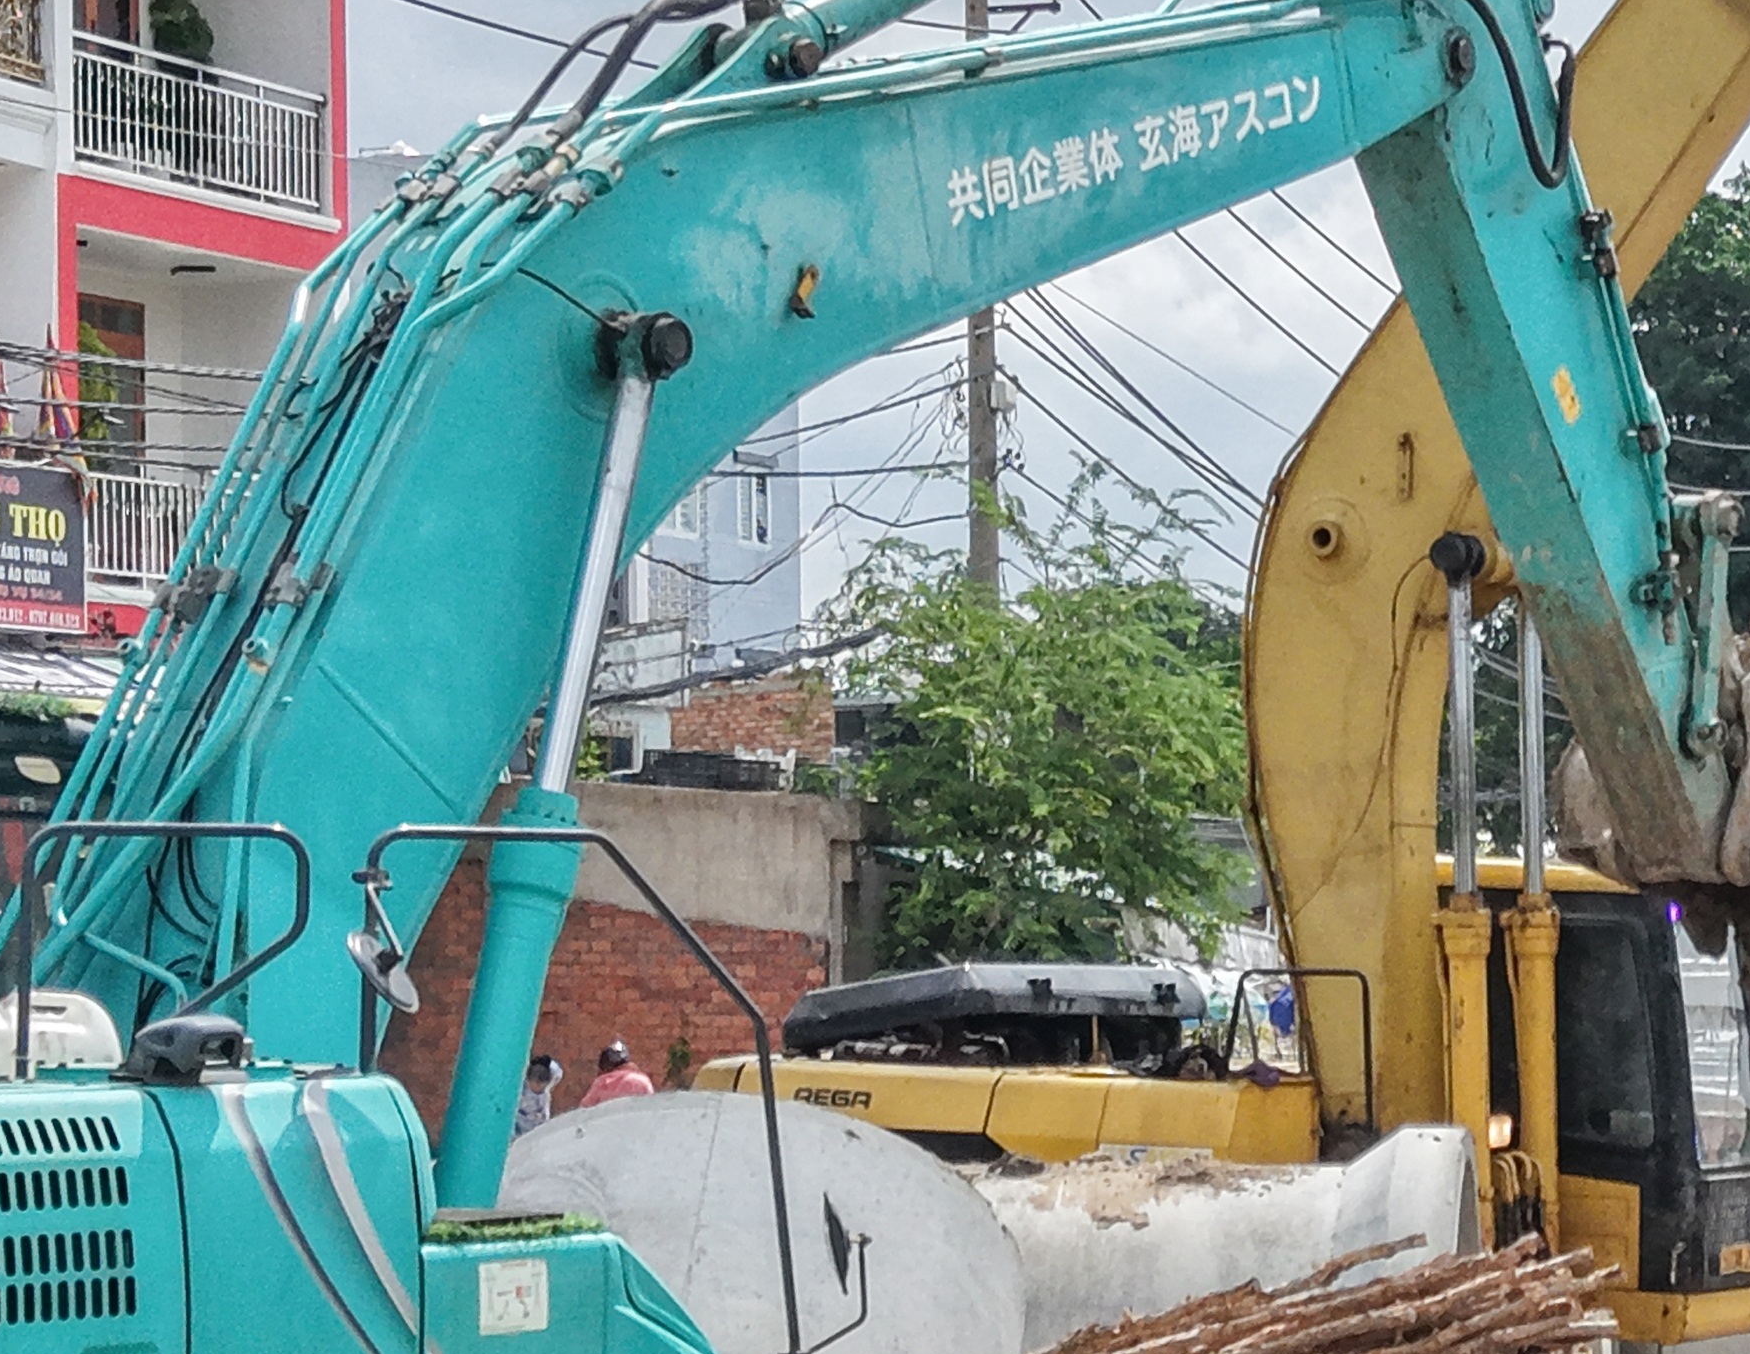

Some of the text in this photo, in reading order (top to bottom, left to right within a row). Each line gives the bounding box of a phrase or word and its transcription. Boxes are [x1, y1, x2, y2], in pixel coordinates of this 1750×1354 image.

[948, 76, 1320, 227] 共同企業体 玄海アスコン
[9, 503, 66, 547] THỌ
[7, 563, 21, 582] ÁO
[24, 567, 51, 585] QUAN
[793, 1087, 872, 1110] REGA
